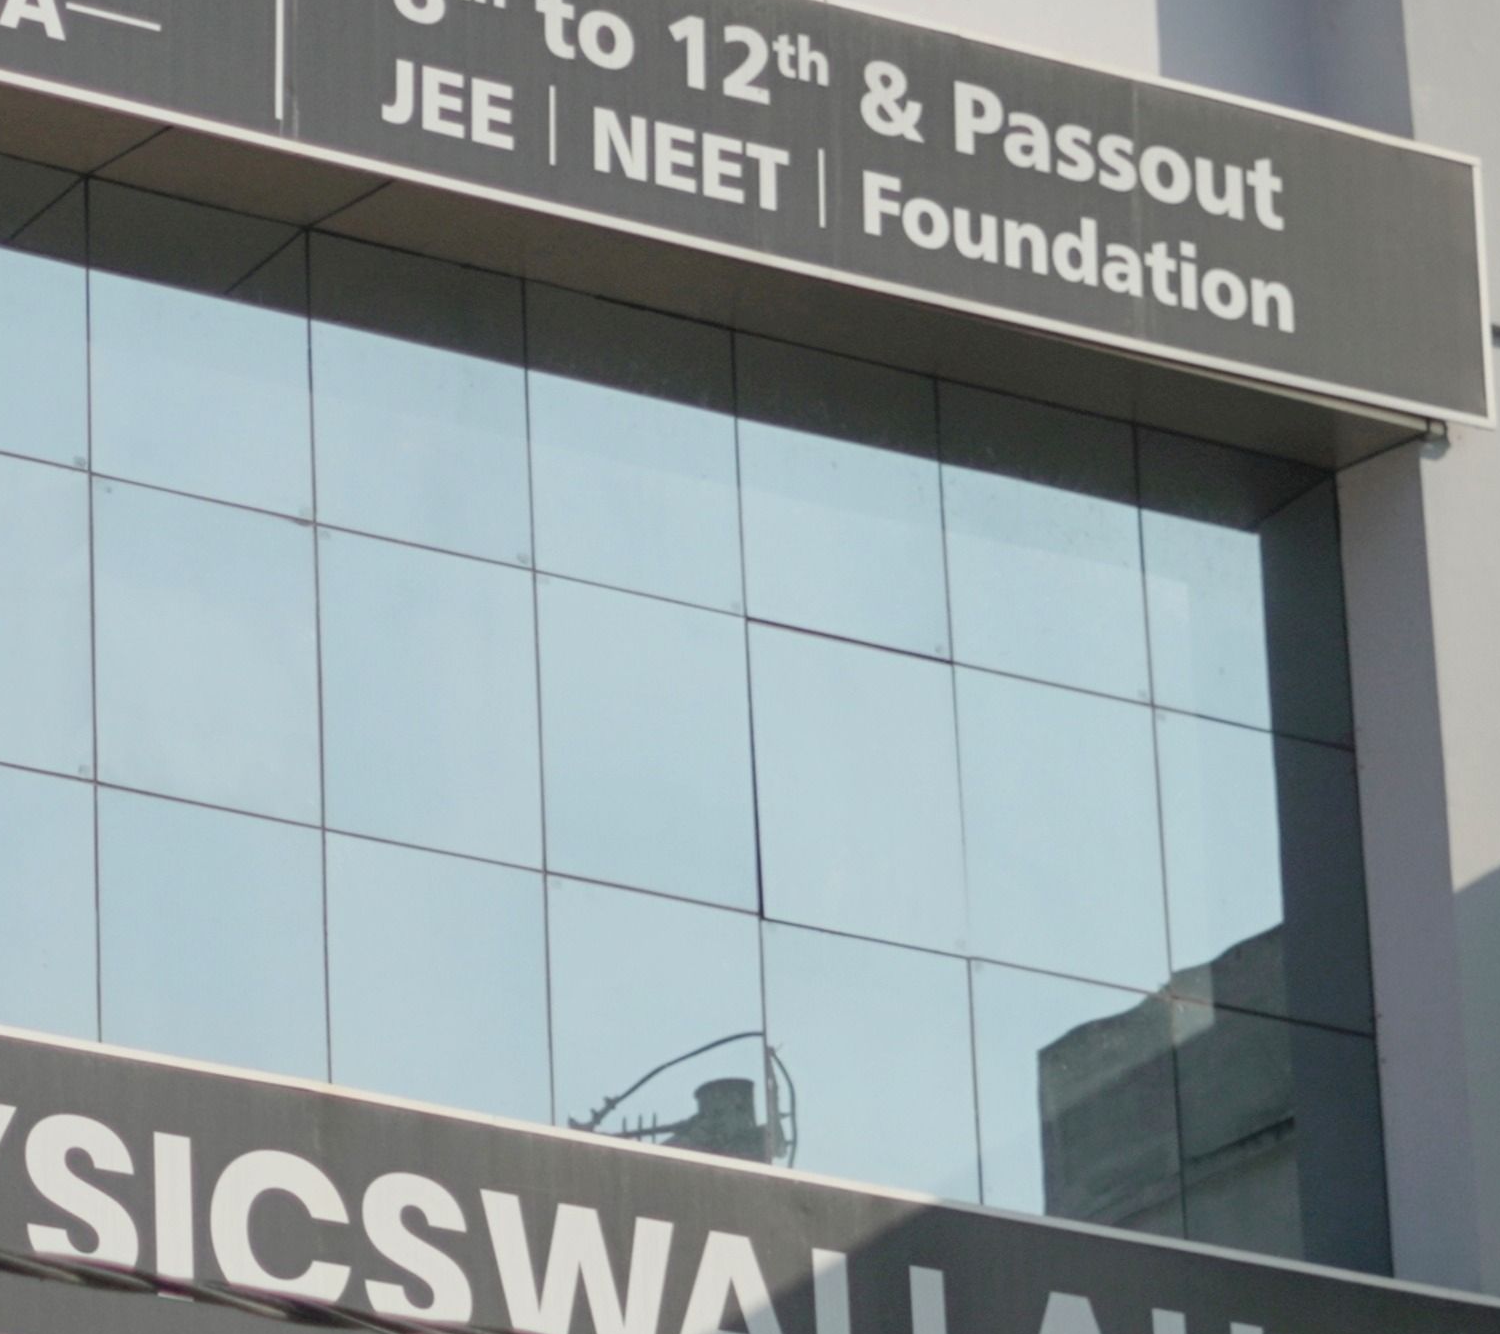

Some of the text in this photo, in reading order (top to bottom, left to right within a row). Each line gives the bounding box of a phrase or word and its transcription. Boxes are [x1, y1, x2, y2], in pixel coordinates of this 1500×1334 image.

[381, 58, 1296, 335] JEE NEET Foundation
[668, 14, 831, 107] 12th
[859, 60, 925, 145] &
[952, 80, 1285, 233] Passout
